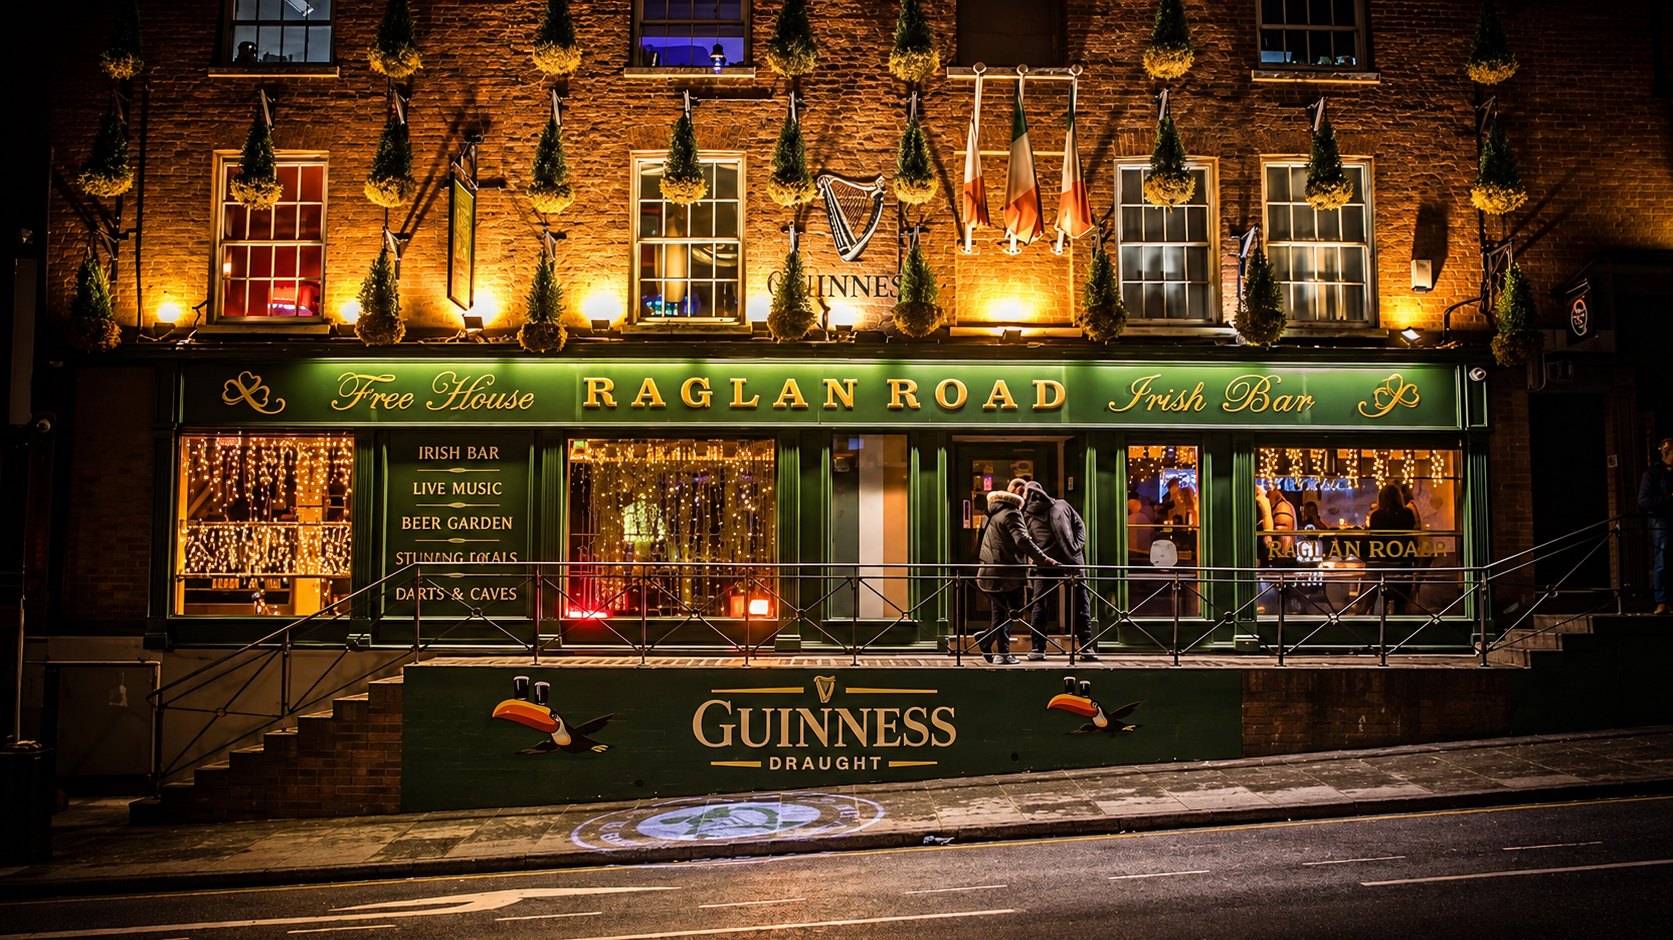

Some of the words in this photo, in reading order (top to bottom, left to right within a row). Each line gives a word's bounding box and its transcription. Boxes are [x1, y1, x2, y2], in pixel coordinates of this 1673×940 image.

[330, 372, 414, 411] Free
[425, 371, 535, 411] House
[583, 377, 858, 408] RAGLAN
[887, 378, 1067, 409] ROAD
[1108, 374, 1206, 412] Irish
[1222, 374, 1315, 412] Bar
[418, 446, 460, 460] IRISH
[467, 446, 500, 460] BAR
[413, 482, 446, 496] LIVE
[452, 482, 503, 496] MUSIC
[401, 516, 442, 530] BEER
[447, 516, 513, 530] GARDEN
[396, 587, 445, 600] DARTS
[451, 587, 464, 600] &
[470, 587, 518, 600] CAVES
[692, 699, 957, 748] GUINNESS
[769, 756, 882, 771] DRAUGHT
